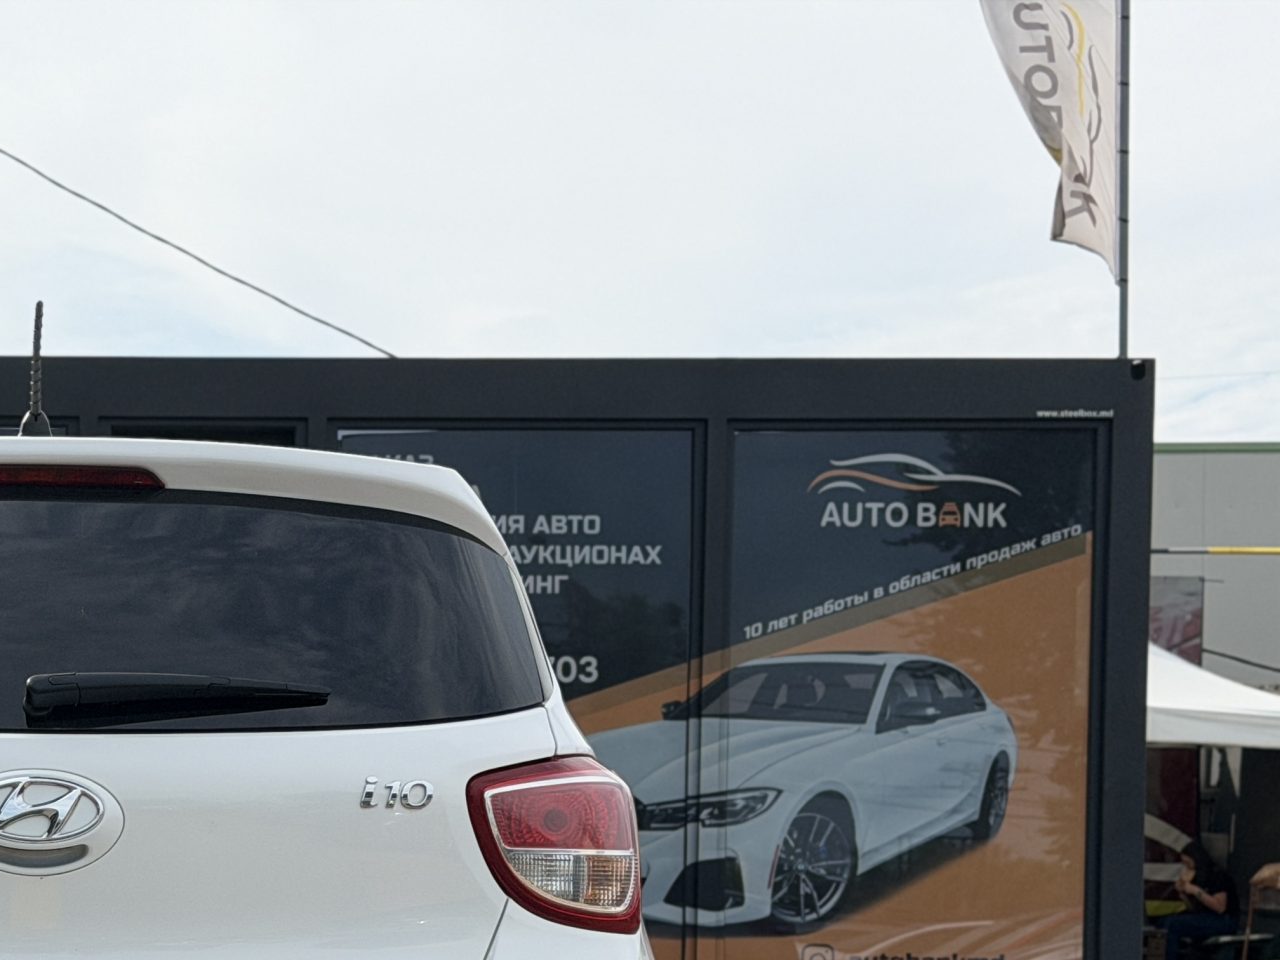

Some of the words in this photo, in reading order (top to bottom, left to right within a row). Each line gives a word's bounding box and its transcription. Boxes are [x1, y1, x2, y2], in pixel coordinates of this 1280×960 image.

[532, 514, 601, 535] АВТО
[820, 501, 908, 528] AUTO
[743, 621, 763, 639] 10
[767, 613, 799, 633] лет
[802, 590, 869, 624] работы
[873, 586, 885, 600] в
[888, 562, 961, 594] области
[965, 537, 1037, 569] продаж
[1040, 524, 1082, 547] авто
[360, 776, 434, 810] i10
